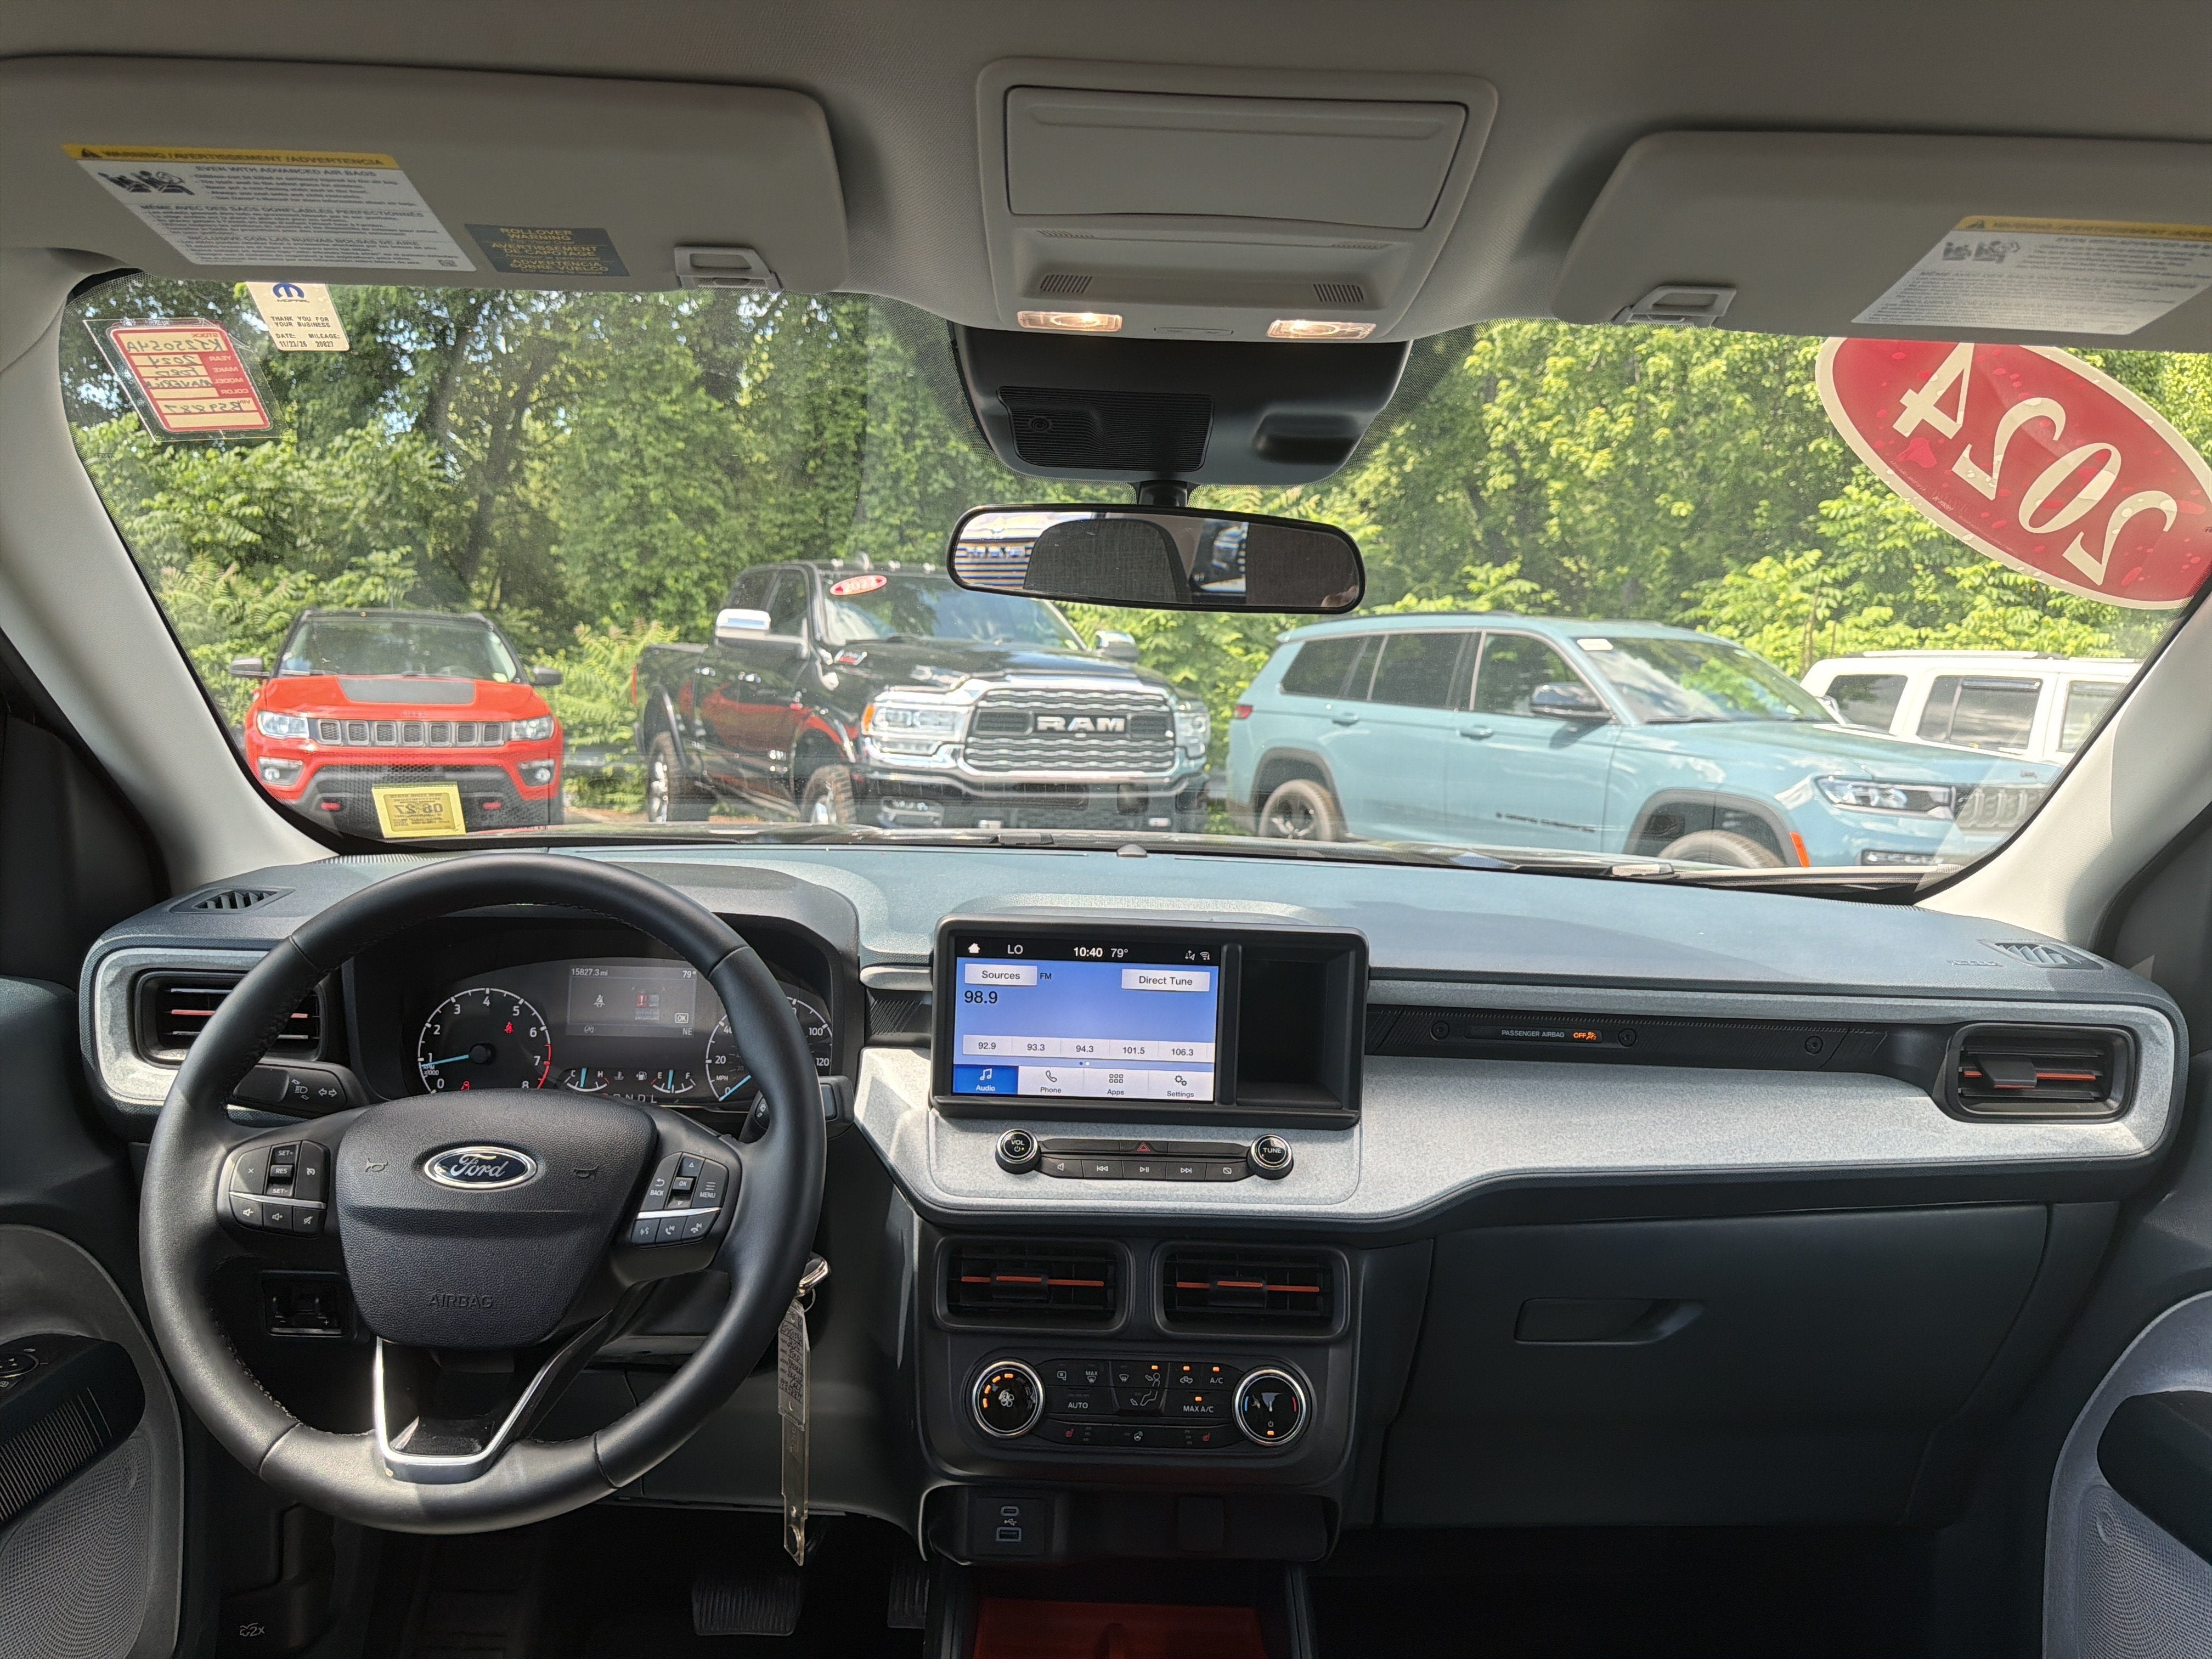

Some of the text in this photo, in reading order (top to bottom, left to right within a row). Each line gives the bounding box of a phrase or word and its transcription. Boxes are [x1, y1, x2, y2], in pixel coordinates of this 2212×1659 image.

[492, 242, 598, 252] AVERTISSEMENT
[512, 258, 602, 267] ADVERTENCIA
[1037, 716, 1125, 732] RAM
[1007, 944, 1128, 958] LO 10:40 79°
[571, 968, 600, 977] 15827.3
[981, 970, 1052, 981] Sources FM
[1138, 975, 1193, 986] Direct Tune
[483, 996, 490, 1006] 4
[963, 990, 998, 1005] 98.9
[454, 1004, 461, 1014] 3
[512, 1006, 520, 1016] 5
[433, 1024, 441, 1035] 2
[529, 1027, 537, 1037] 6
[682, 1028, 692, 1036] NE
[808, 1027, 823, 1036] 100
[978, 1042, 996, 1051] 92.9
[1027, 1043, 1045, 1052] 93.3
[1076, 1045, 1094, 1053] 94.3
[1122, 1046, 1146, 1055] 101.5
[1171, 1048, 1194, 1057] 106.3
[428, 1052, 432, 1063] 1
[534, 1056, 540, 1066] 7
[715, 1056, 726, 1065] 20
[815, 1057, 830, 1066] 120
[437, 1078, 444, 1089] 0
[522, 1080, 529, 1089] 8
[975, 1084, 996, 1092] Audio
[1107, 1088, 1125, 1096] Apps
[1166, 1090, 1194, 1098] Settings
[637, 1094, 646, 1102] D
[651, 1094, 657, 1103] L
[450, 1153, 510, 1177] Ford
[428, 1293, 494, 1308] AIRBAG
[1210, 1376, 1224, 1384] A/C
[250, 1624, 265, 1637] 2x
